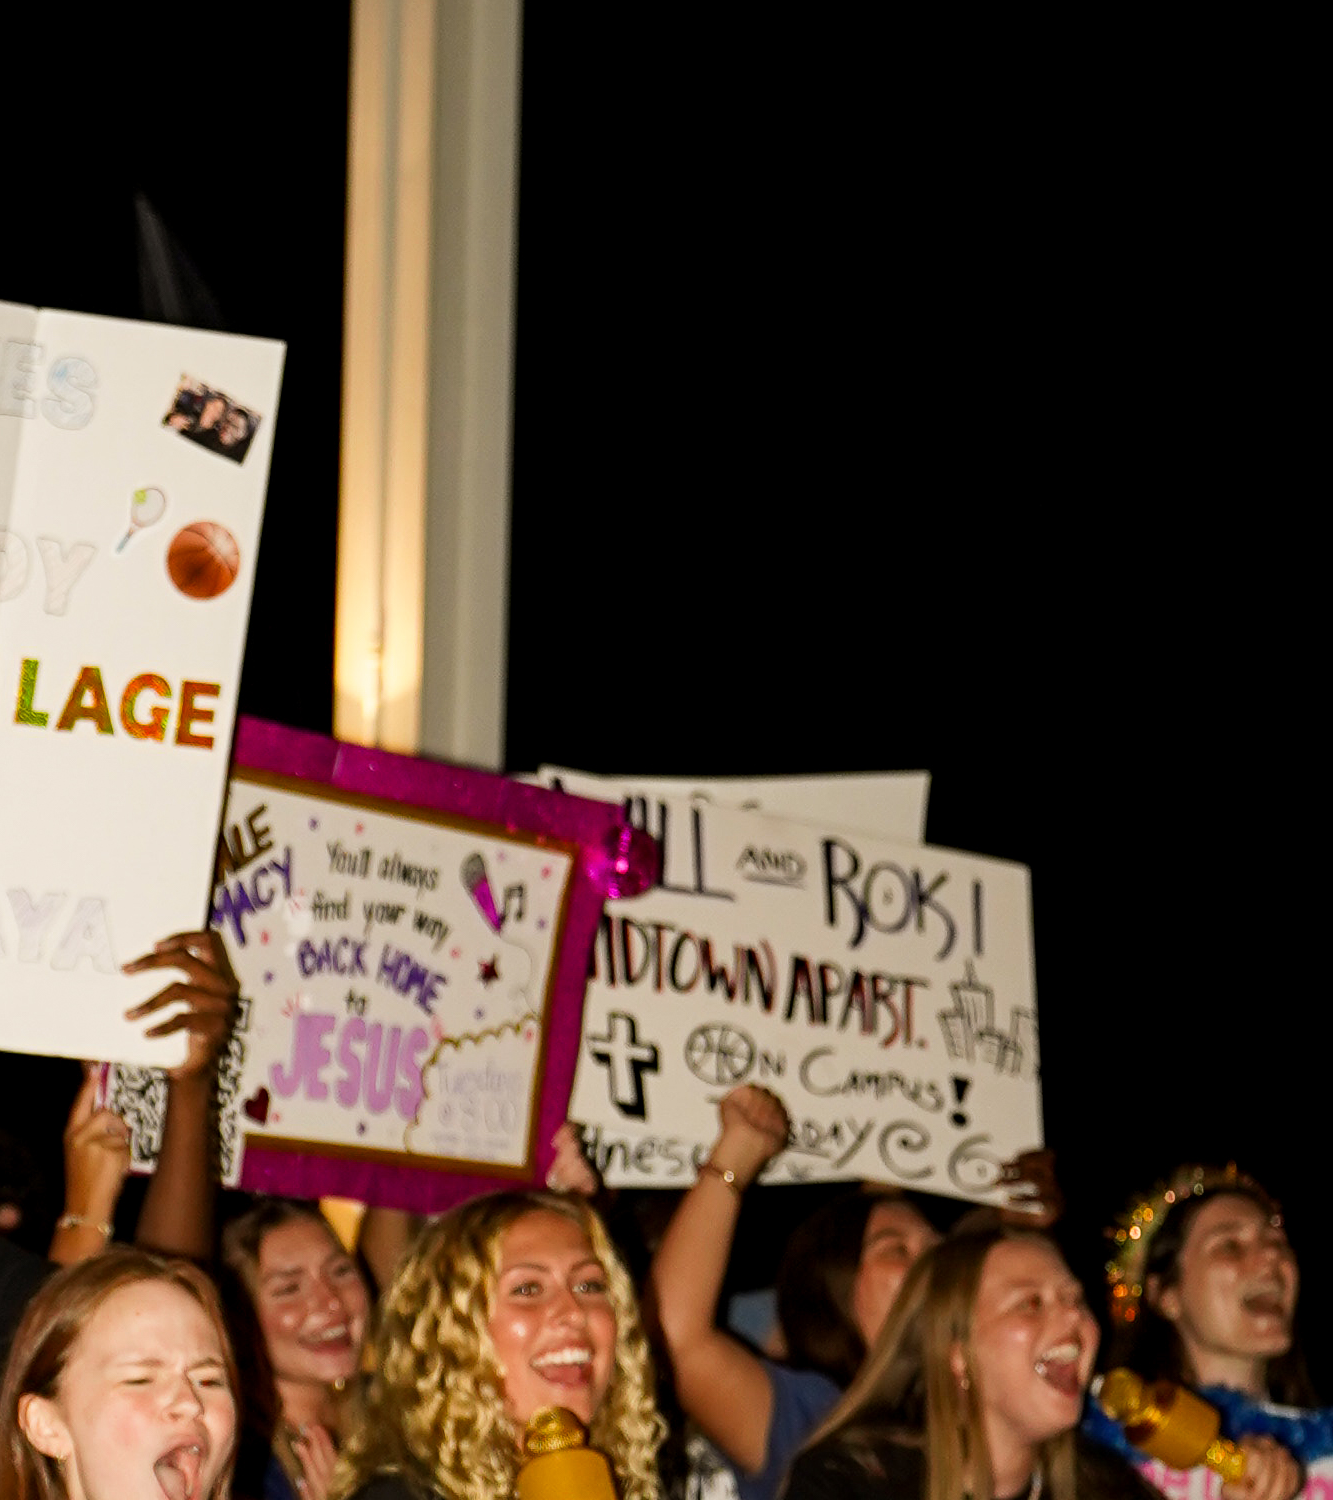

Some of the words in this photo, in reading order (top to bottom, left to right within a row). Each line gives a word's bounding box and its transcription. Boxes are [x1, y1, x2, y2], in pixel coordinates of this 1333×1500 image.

[378, 854, 440, 900] always
[311, 892, 349, 921] find
[363, 900, 405, 937] your
[412, 910, 452, 955] way
[299, 936, 367, 978] BACK
[377, 942, 448, 1016] HOME
[345, 990, 367, 1017] to
[270, 1013, 429, 1121] JESUS
[879, 1117, 935, 1180] @
